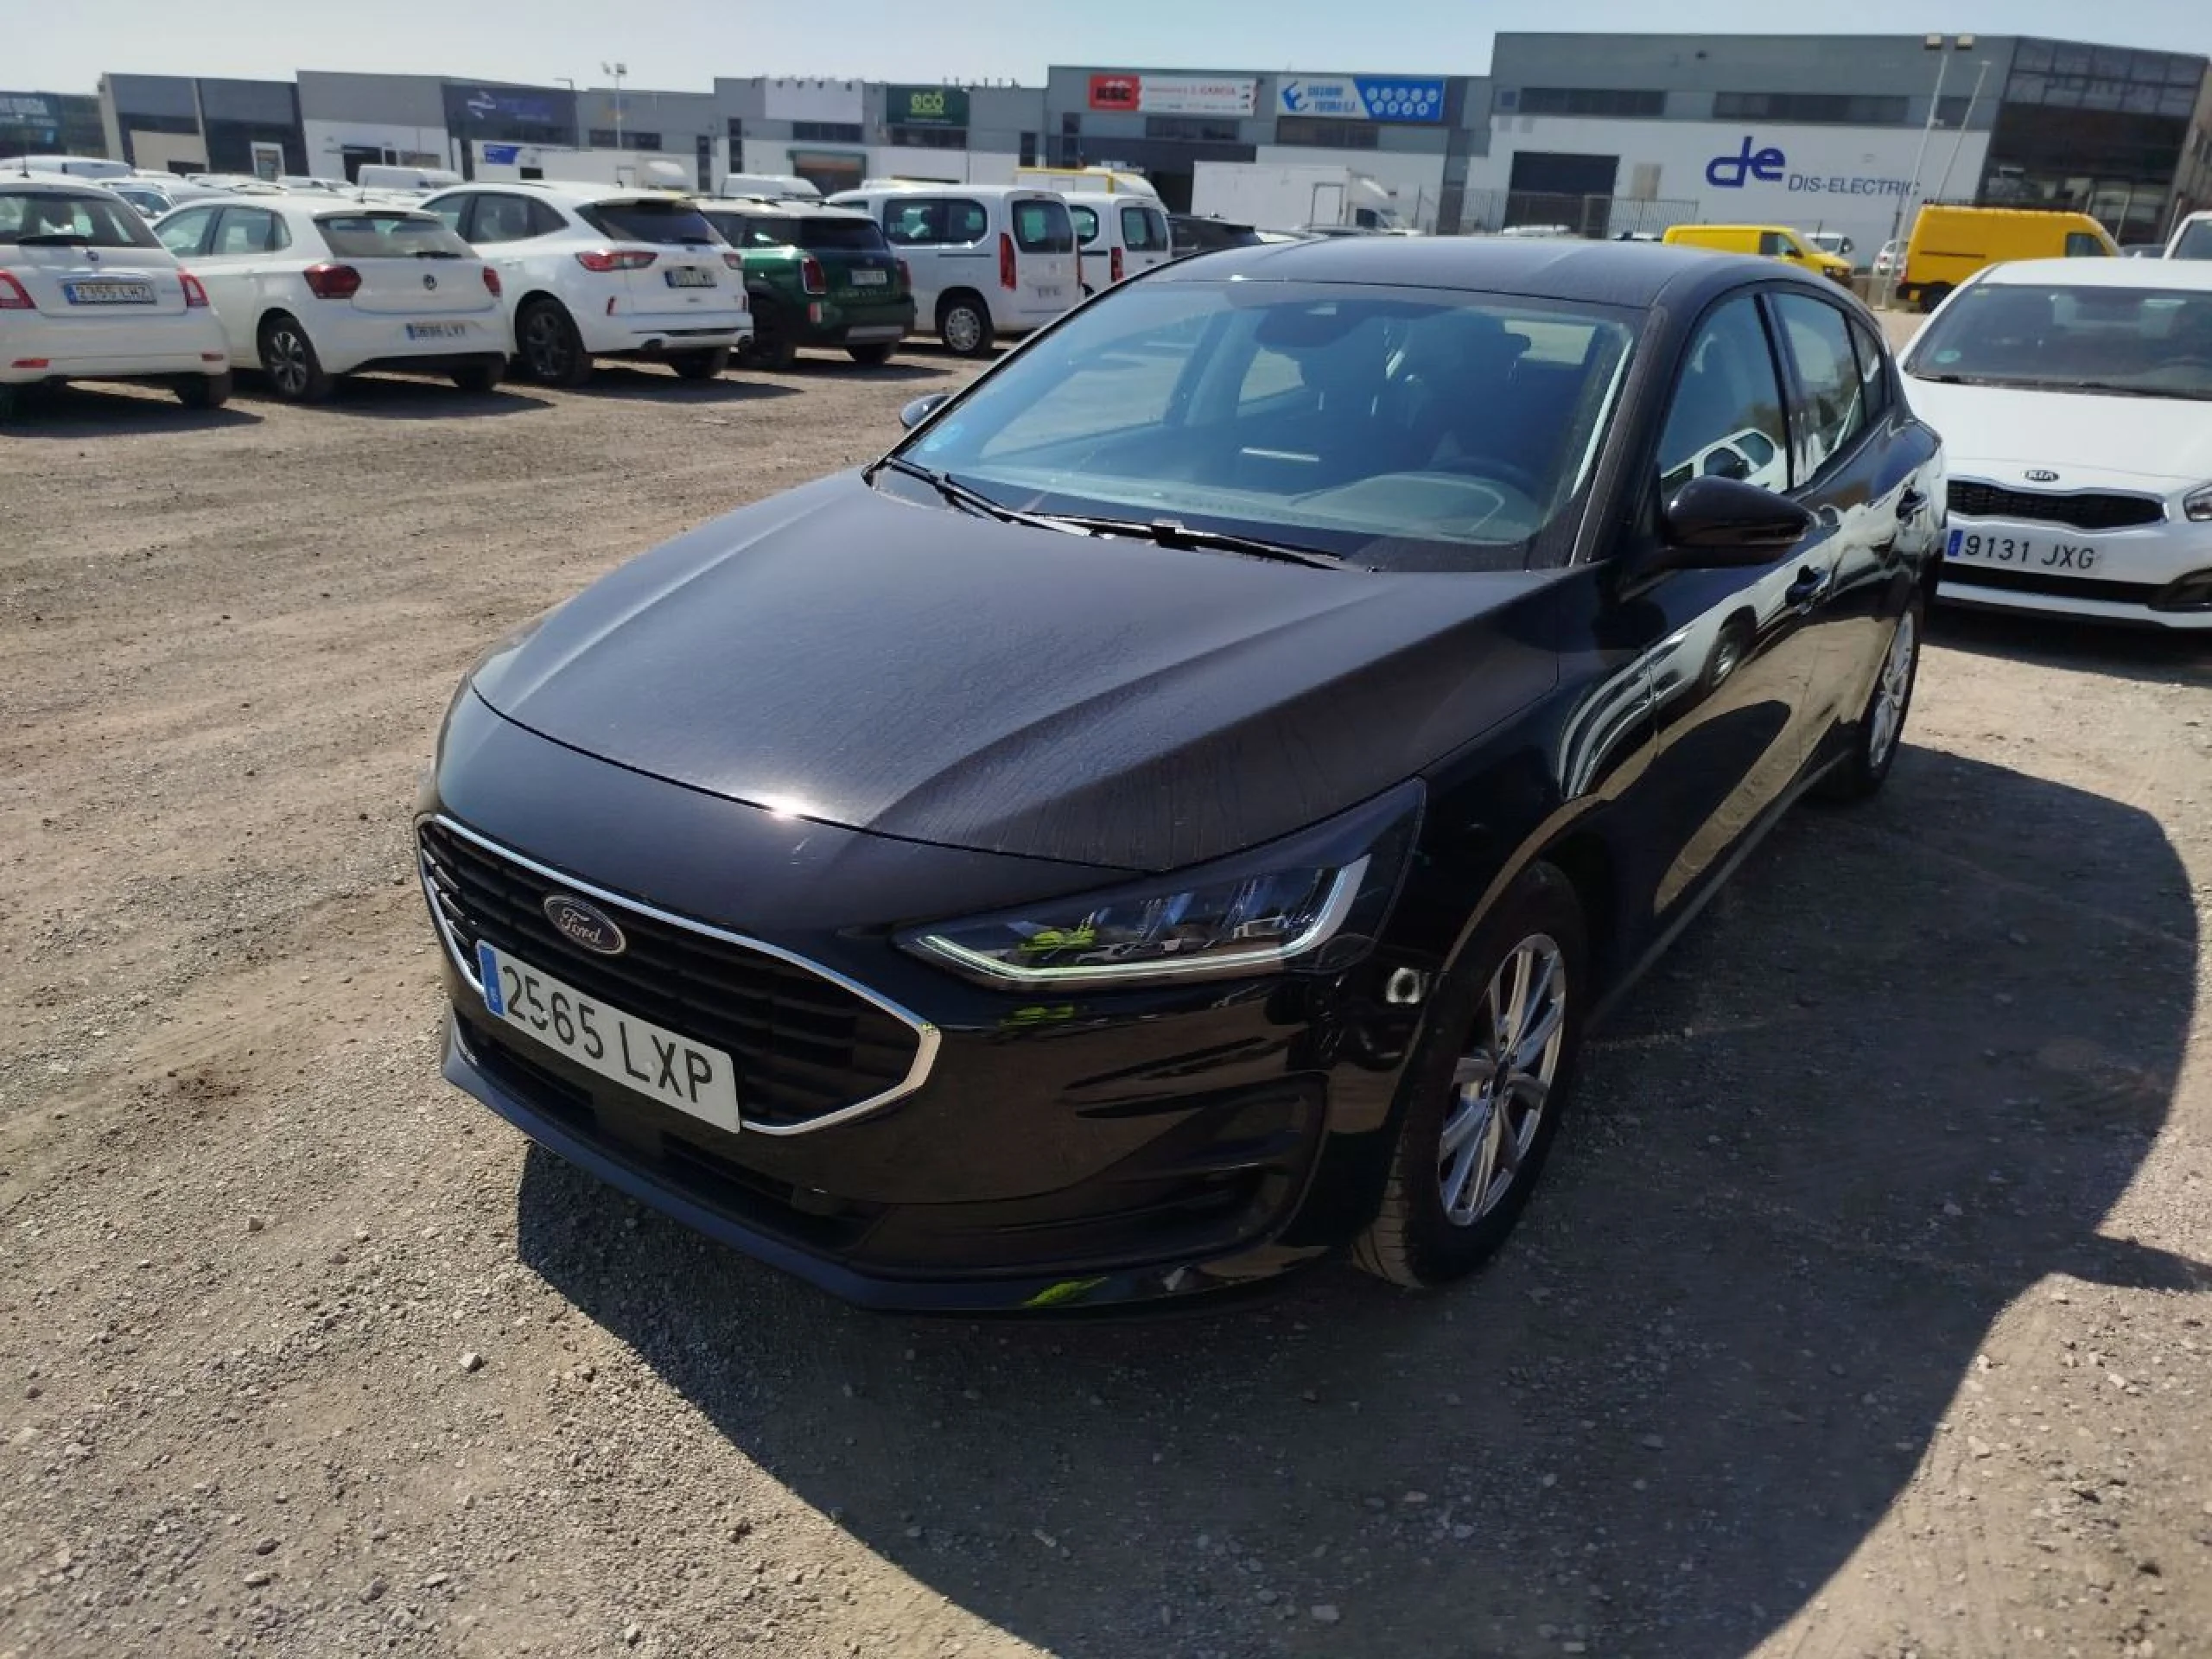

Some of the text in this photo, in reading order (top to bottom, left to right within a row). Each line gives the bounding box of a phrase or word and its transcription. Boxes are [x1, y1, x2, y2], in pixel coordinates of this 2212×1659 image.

[1965, 534, 2095, 569] 9131 JXG
[559, 906, 602, 944] Ford
[502, 964, 713, 1103] 2565 LXP
